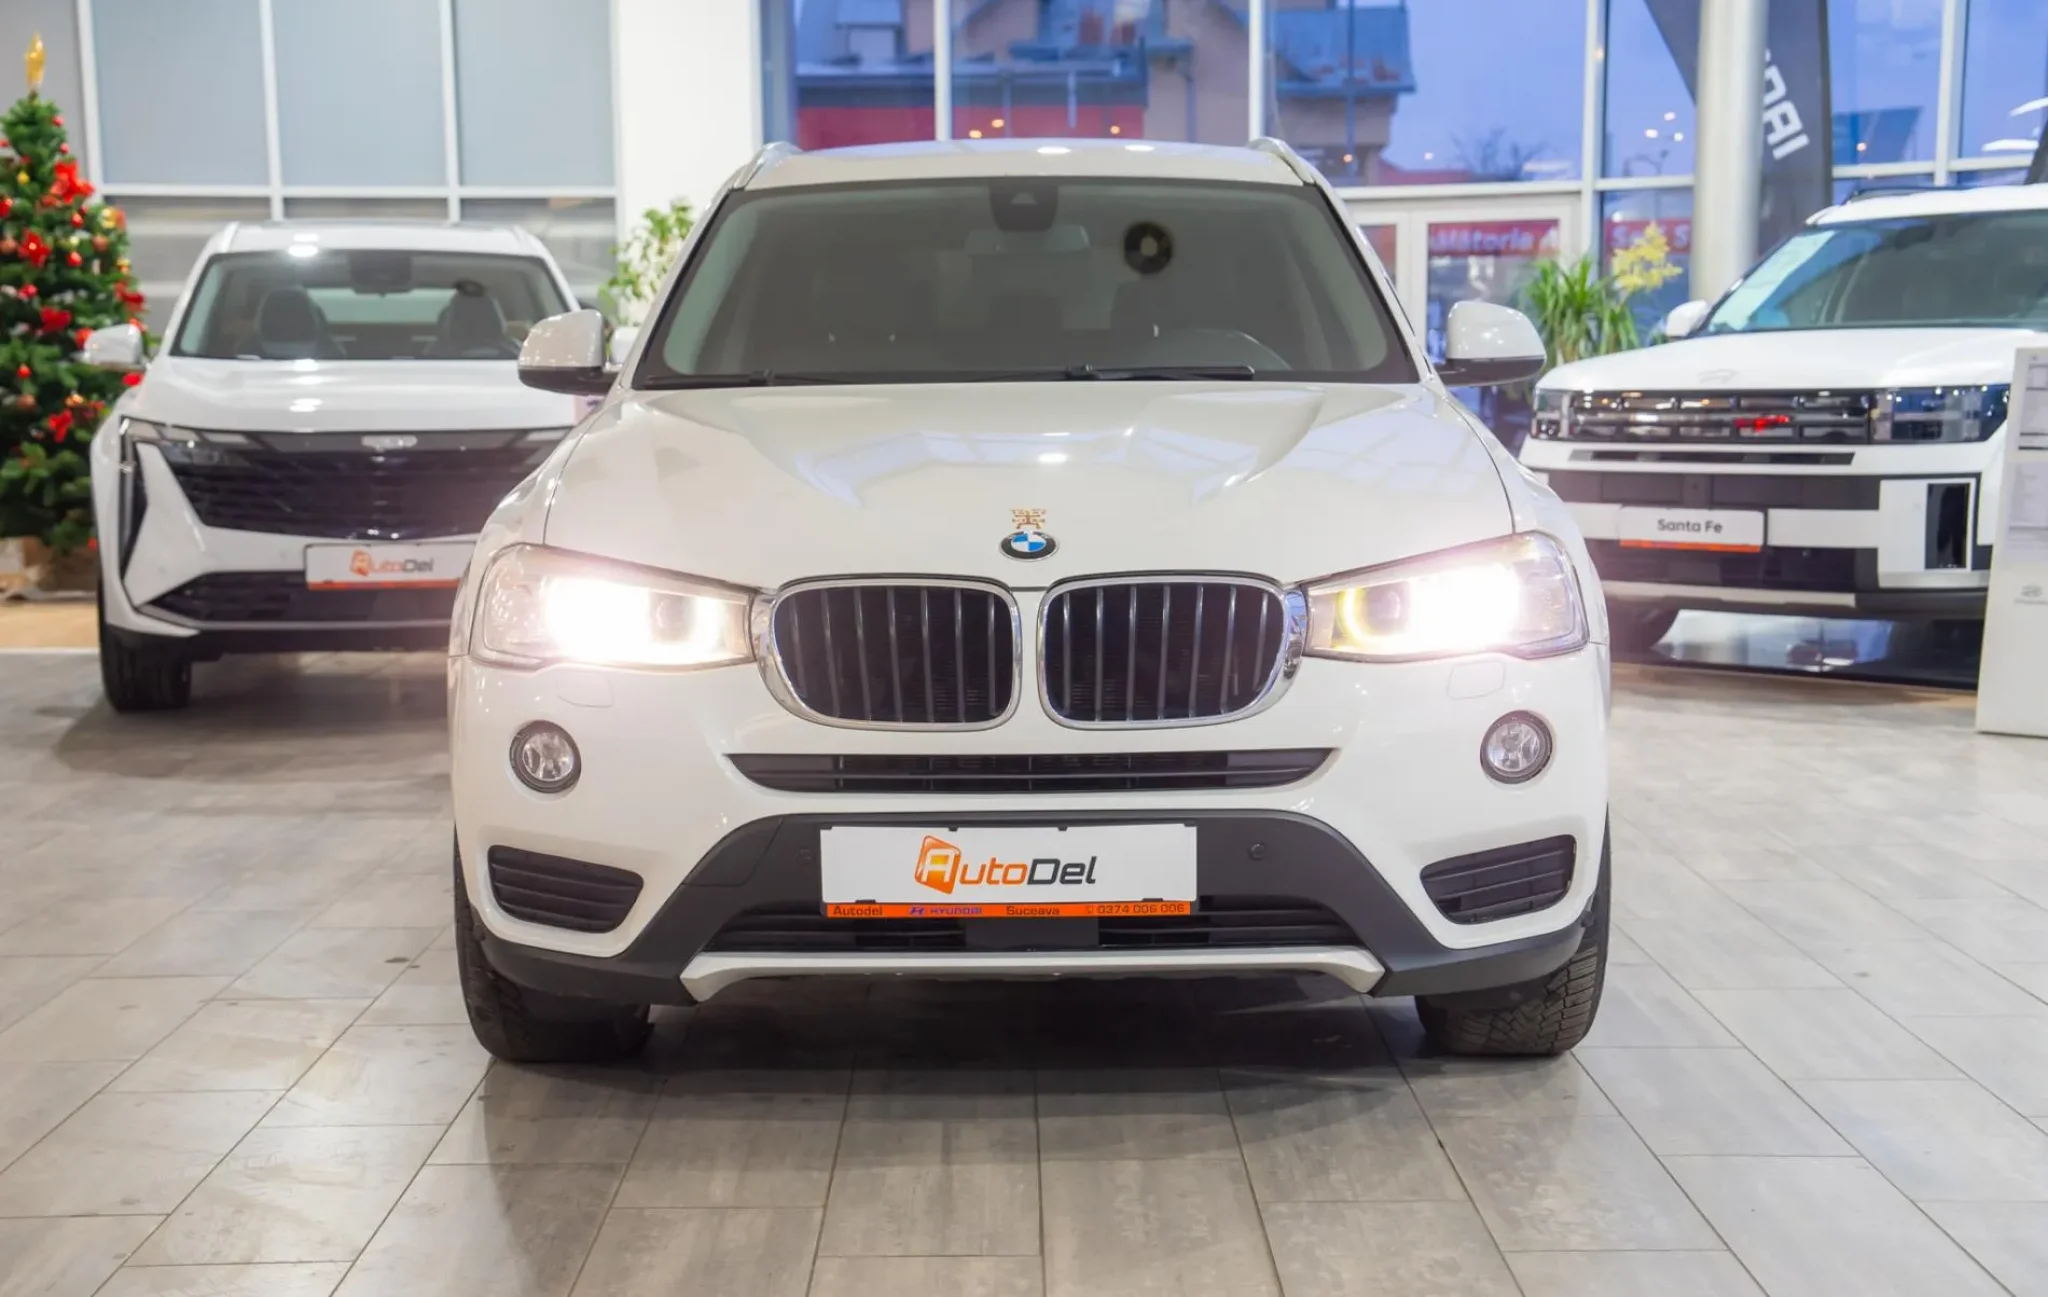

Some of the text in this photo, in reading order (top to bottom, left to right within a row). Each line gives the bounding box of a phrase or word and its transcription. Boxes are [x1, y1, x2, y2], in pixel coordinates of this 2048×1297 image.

[1657, 518, 1724, 534] Santa Fe
[920, 847, 1098, 886] AutoDel
[832, 905, 884, 917] Autodel
[1005, 904, 1061, 916] Suceava
[1097, 904, 1130, 914] 0374
[1132, 903, 1158, 914] 006
[1160, 902, 1185, 913] 006
